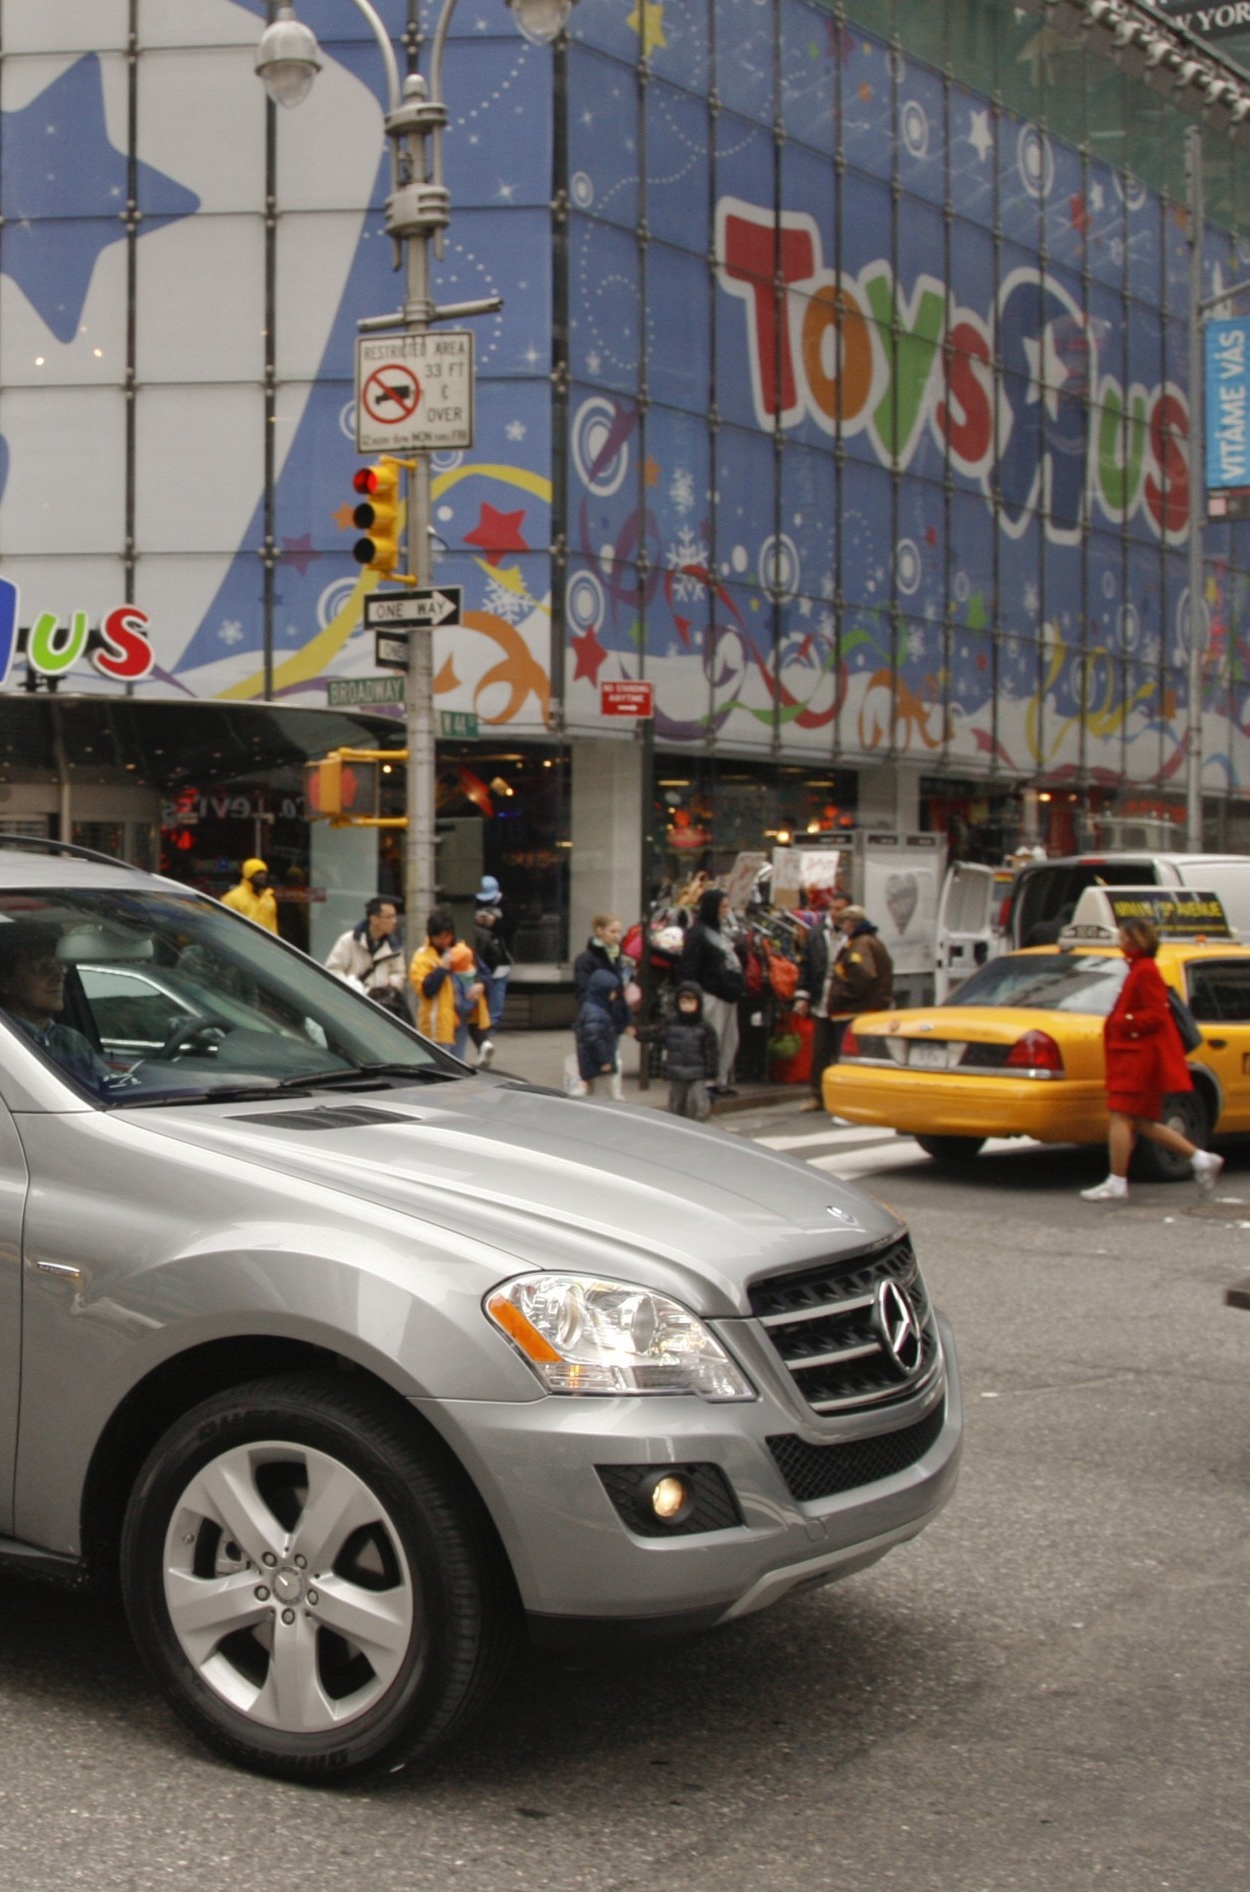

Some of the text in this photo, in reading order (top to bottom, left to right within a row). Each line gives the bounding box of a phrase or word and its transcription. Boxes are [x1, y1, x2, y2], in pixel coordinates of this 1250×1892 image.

[364, 340, 466, 360] RESTRICTED AREA
[425, 361, 464, 378] 33 FT
[427, 406, 463, 423] OVER
[375, 601, 446, 620] ONE WAY
[329, 679, 401, 704] BROADWAY
